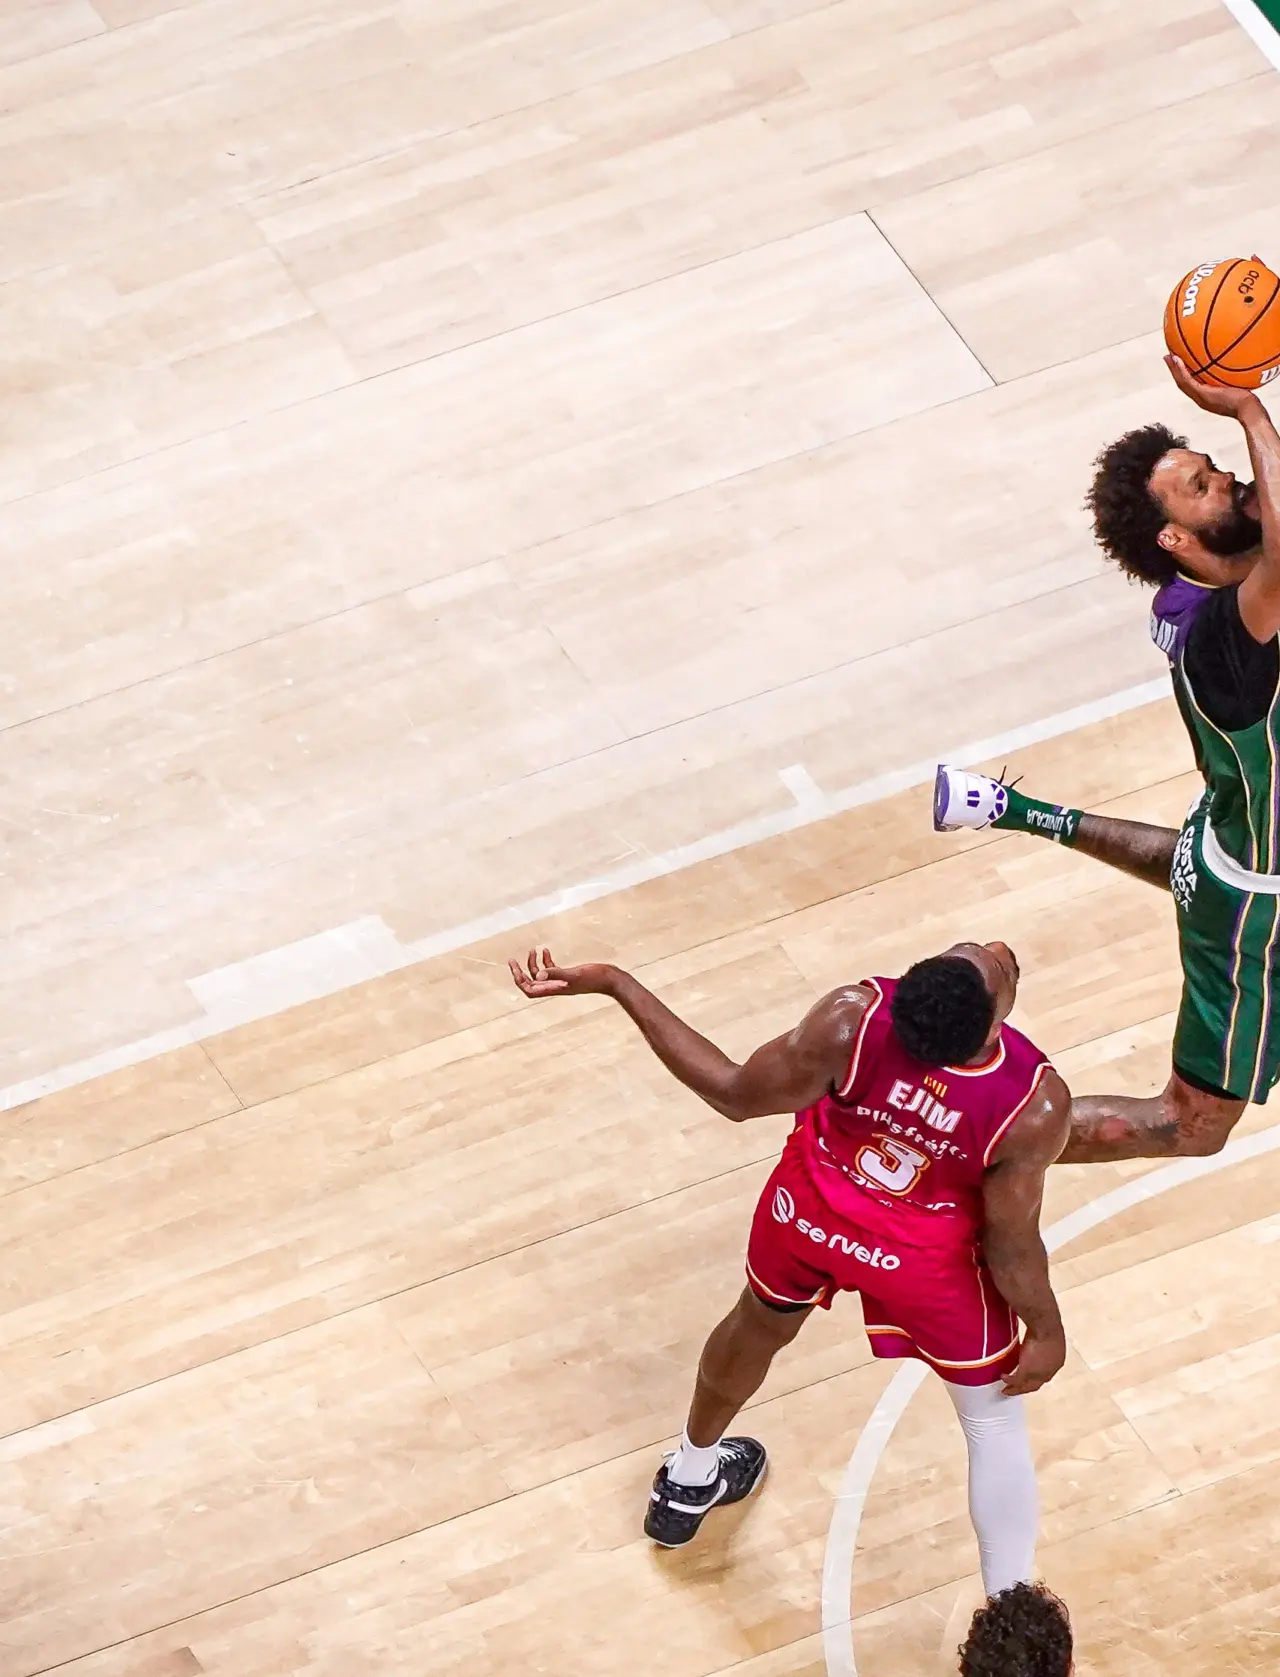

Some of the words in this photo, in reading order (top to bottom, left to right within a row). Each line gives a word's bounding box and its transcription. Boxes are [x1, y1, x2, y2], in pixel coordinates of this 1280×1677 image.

[1238, 270, 1260, 295] acb
[1026, 809, 1064, 831] UNICAJA
[1181, 825, 1197, 892] COSTA
[886, 1078, 963, 1133] EJIM
[855, 1133, 931, 1196] 3
[795, 1218, 901, 1270] serveto
